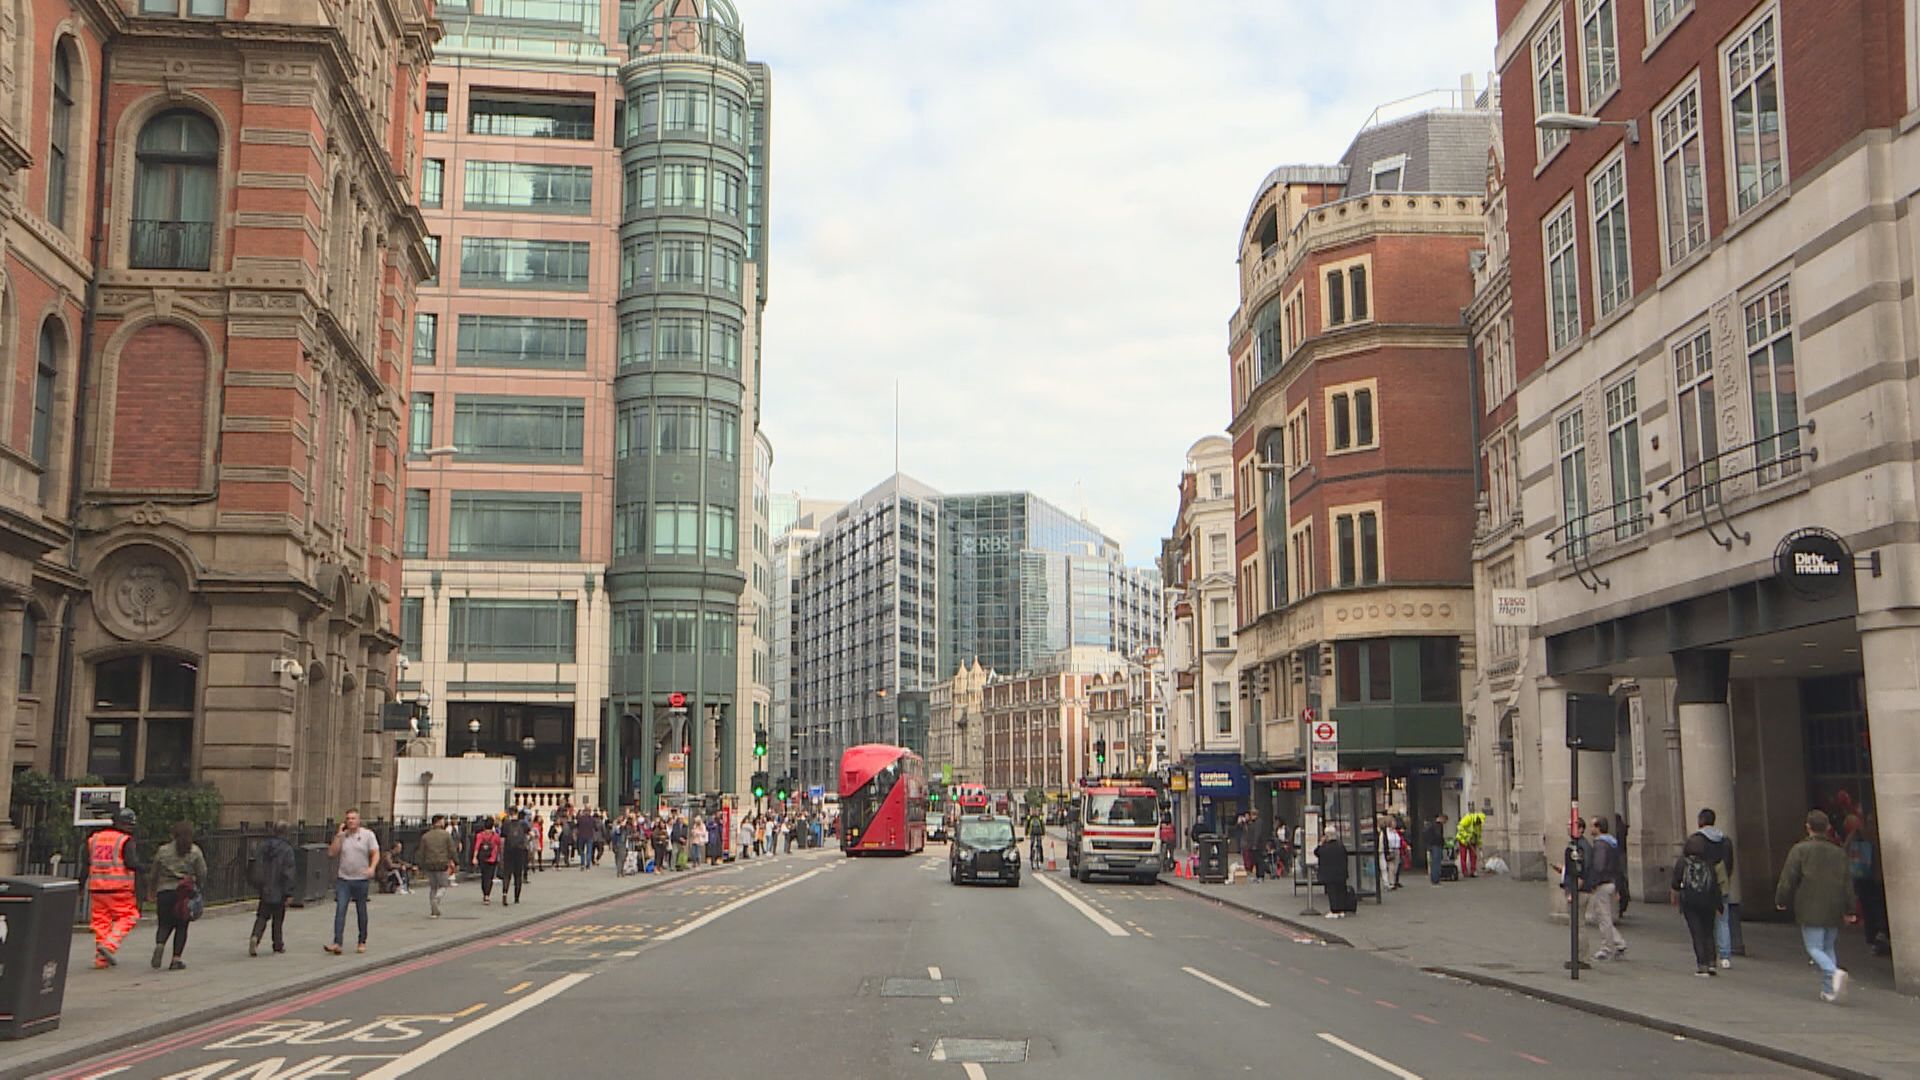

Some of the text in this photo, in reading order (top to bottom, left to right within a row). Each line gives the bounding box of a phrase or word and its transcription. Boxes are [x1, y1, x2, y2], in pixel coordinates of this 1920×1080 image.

[980, 537, 1011, 552] RBS
[1795, 552, 1824, 568] Dirty
[1796, 562, 1839, 575] martini
[1498, 597, 1526, 606] TESCO
[1304, 709, 1312, 720] K
[202, 1016, 455, 1050] BUS
